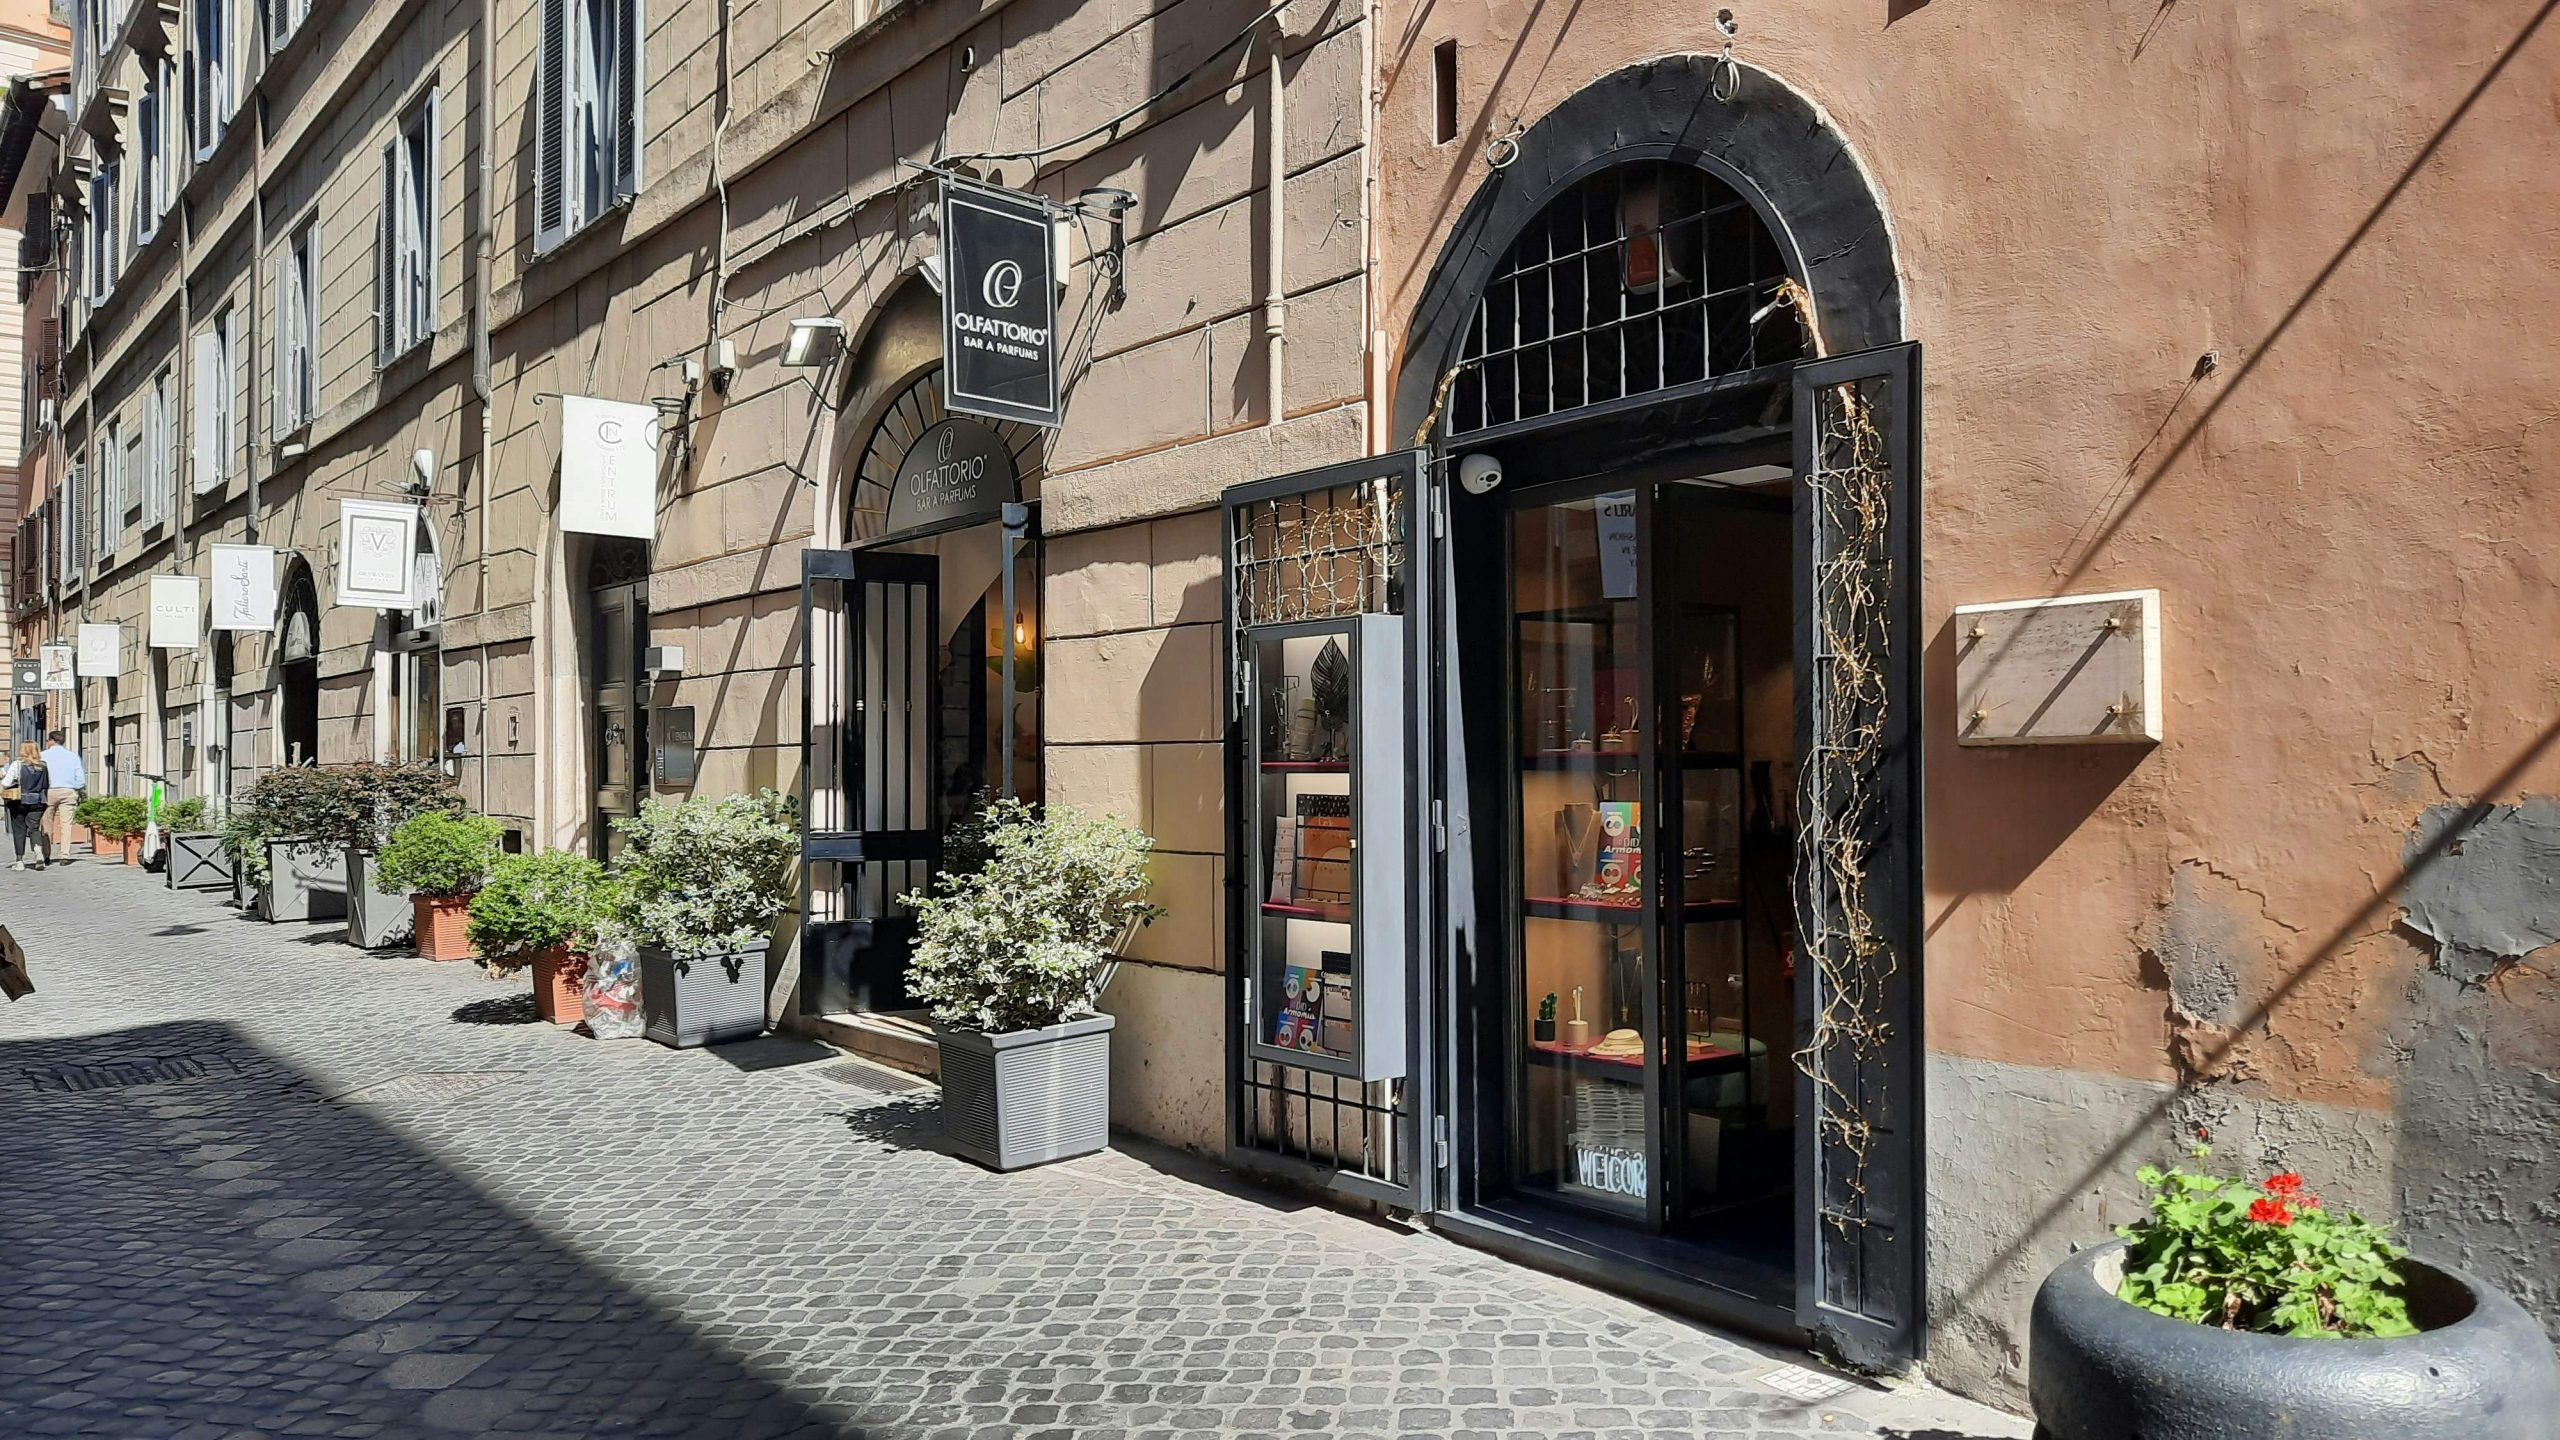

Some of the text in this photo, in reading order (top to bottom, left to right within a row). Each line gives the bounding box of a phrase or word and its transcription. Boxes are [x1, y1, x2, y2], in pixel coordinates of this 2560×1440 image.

[955, 312, 1046, 346] OLFATTORIO
[963, 336, 1039, 361] BAR A PARFUMS
[910, 456, 984, 496] OLFATTORIO
[916, 484, 977, 512] BAR A PARFUMS
[155, 605, 195, 613] CULTI
